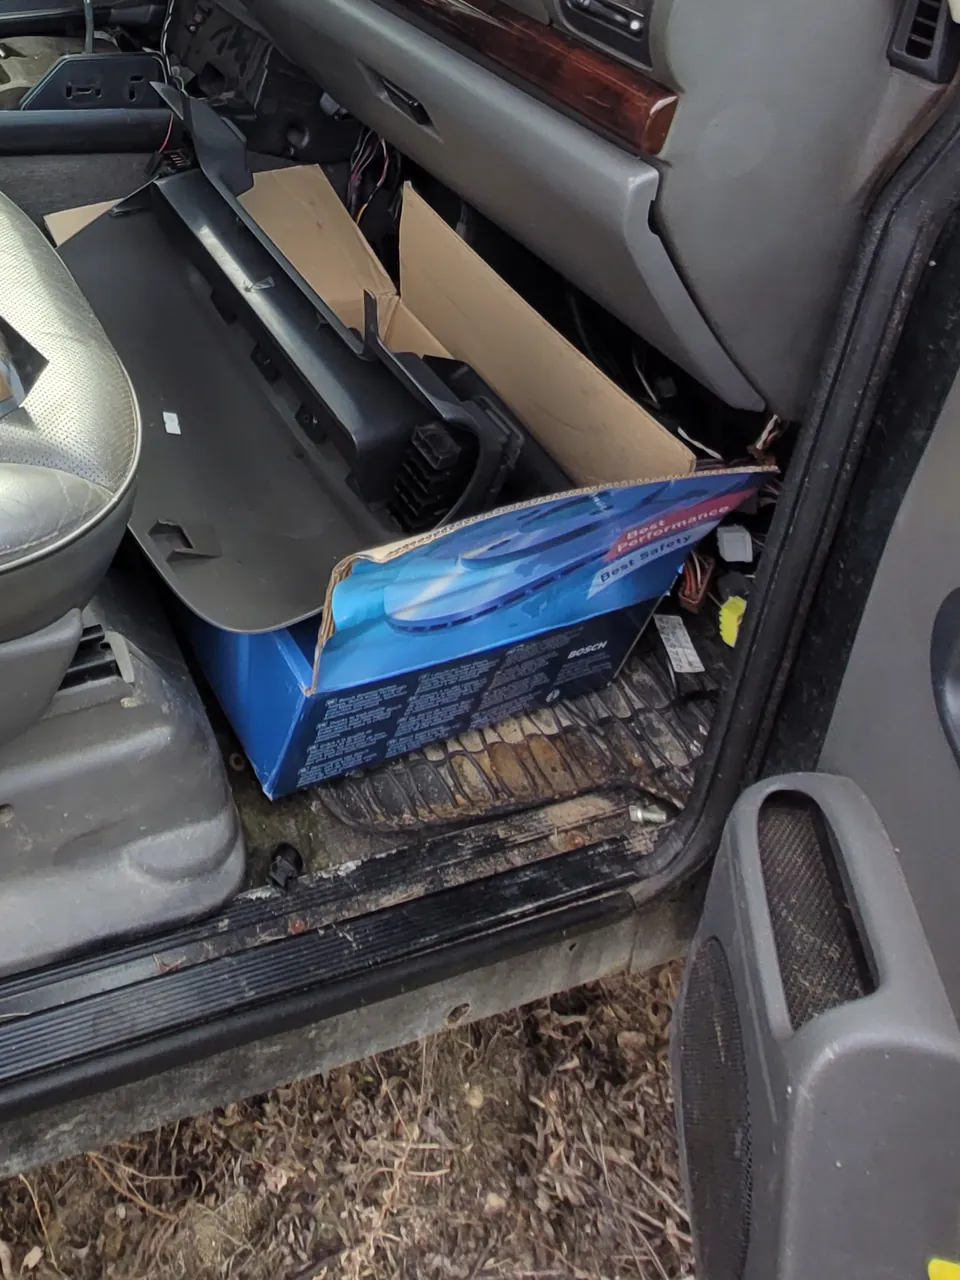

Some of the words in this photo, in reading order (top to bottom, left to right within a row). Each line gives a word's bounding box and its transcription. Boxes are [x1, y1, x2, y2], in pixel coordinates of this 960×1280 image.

[617, 504, 731, 553] Performance
[626, 519, 666, 540] Best
[599, 560, 636, 584] Best
[639, 534, 693, 561] Safety
[566, 640, 609, 660] BOSCH
